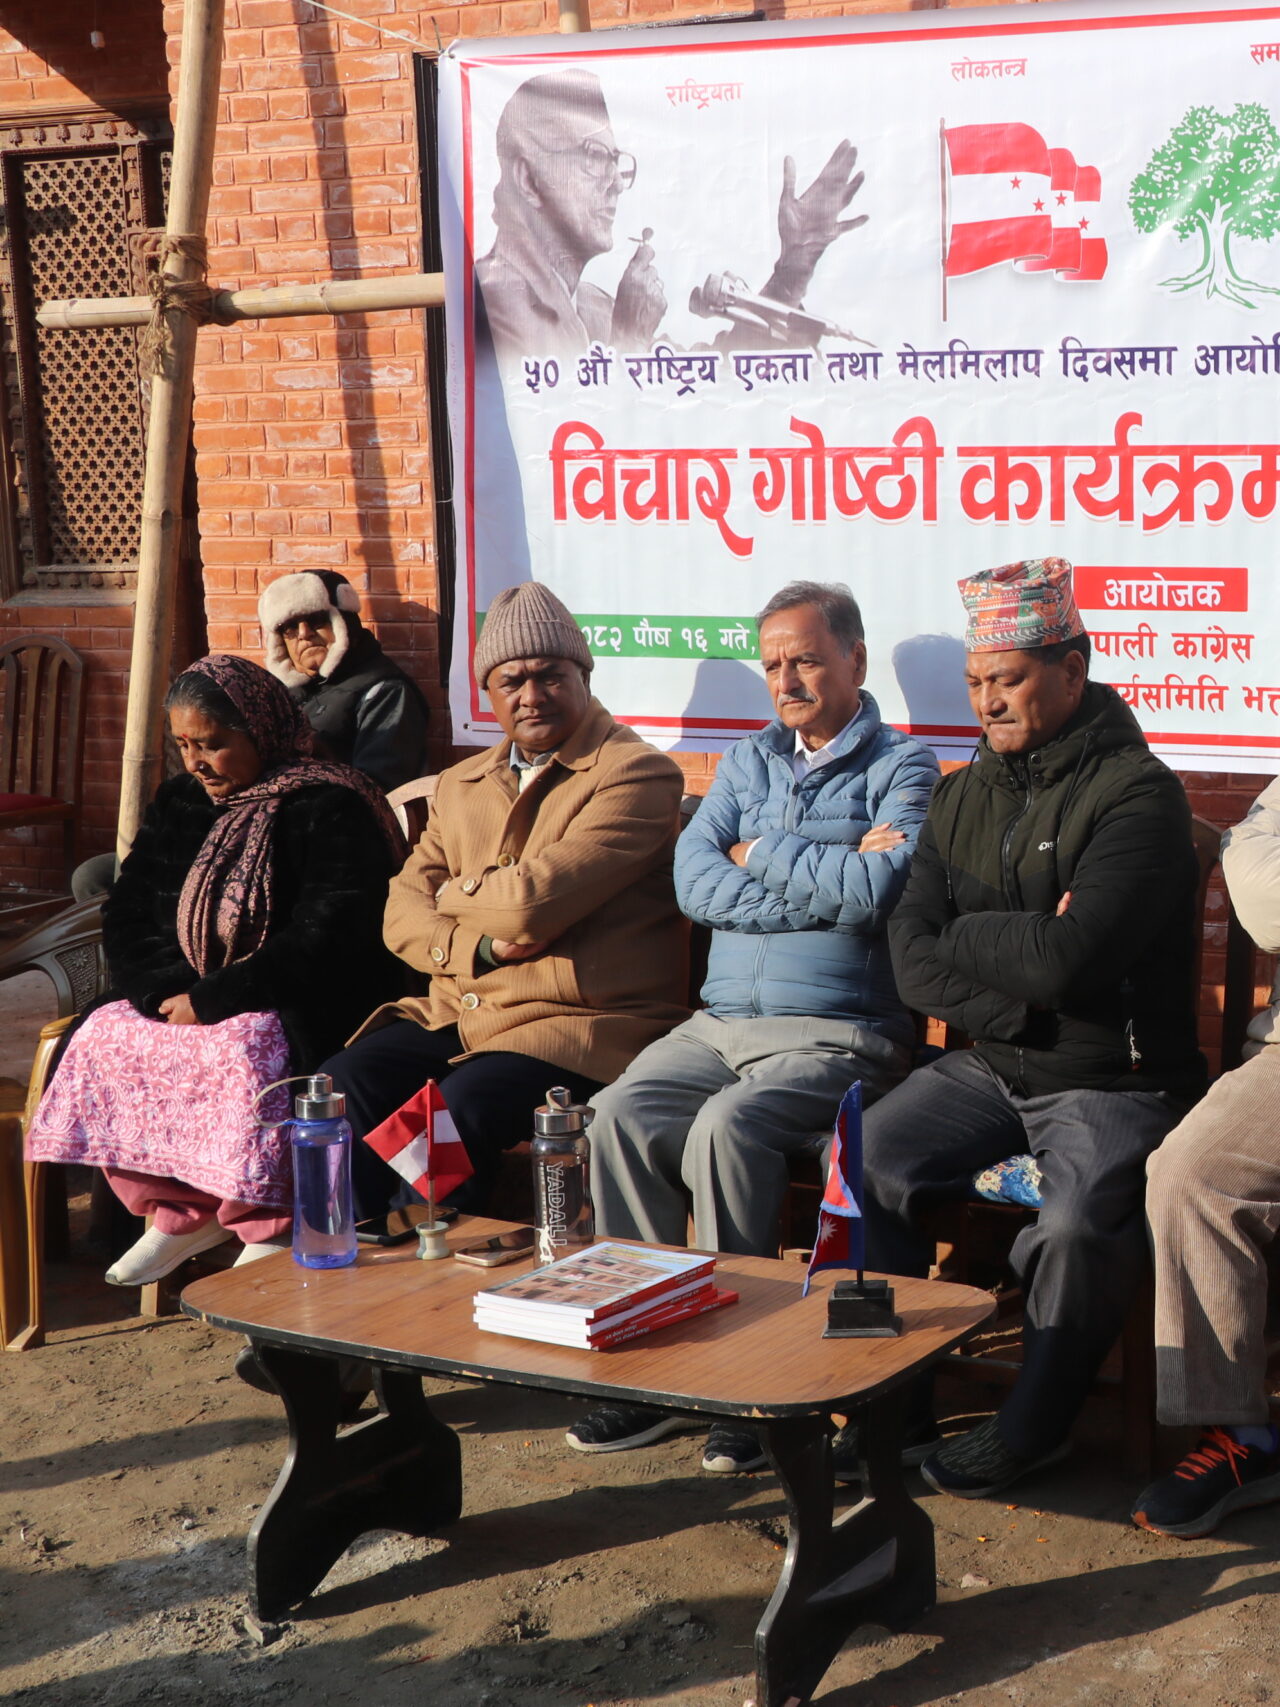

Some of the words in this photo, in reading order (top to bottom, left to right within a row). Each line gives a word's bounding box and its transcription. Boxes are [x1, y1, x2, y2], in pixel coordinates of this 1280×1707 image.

[951, 56, 1028, 82] लोकतन्त्र
[665, 78, 744, 110] राष्ट्रियता
[525, 360, 559, 393] ५०
[577, 345, 612, 387] औं
[625, 346, 719, 396] राष्ट्रिय
[733, 353, 813, 392] एकता
[826, 352, 883, 385] तथा
[897, 339, 1044, 381] मेलमिलाप
[1059, 336, 1177, 382] दिवसमा
[549, 420, 754, 557] विचार
[749, 415, 944, 521] गोष्ठी
[1104, 572, 1225, 608] आयोजक
[581, 625, 622, 652] ०८२
[632, 618, 672, 648] पौष
[681, 628, 709, 653] १६
[718, 622, 756, 656] गते,
[1087, 622, 1158, 661] पाली
[1171, 625, 1255, 664] कांग्रेस
[1106, 673, 1229, 713] र्यसमिति
